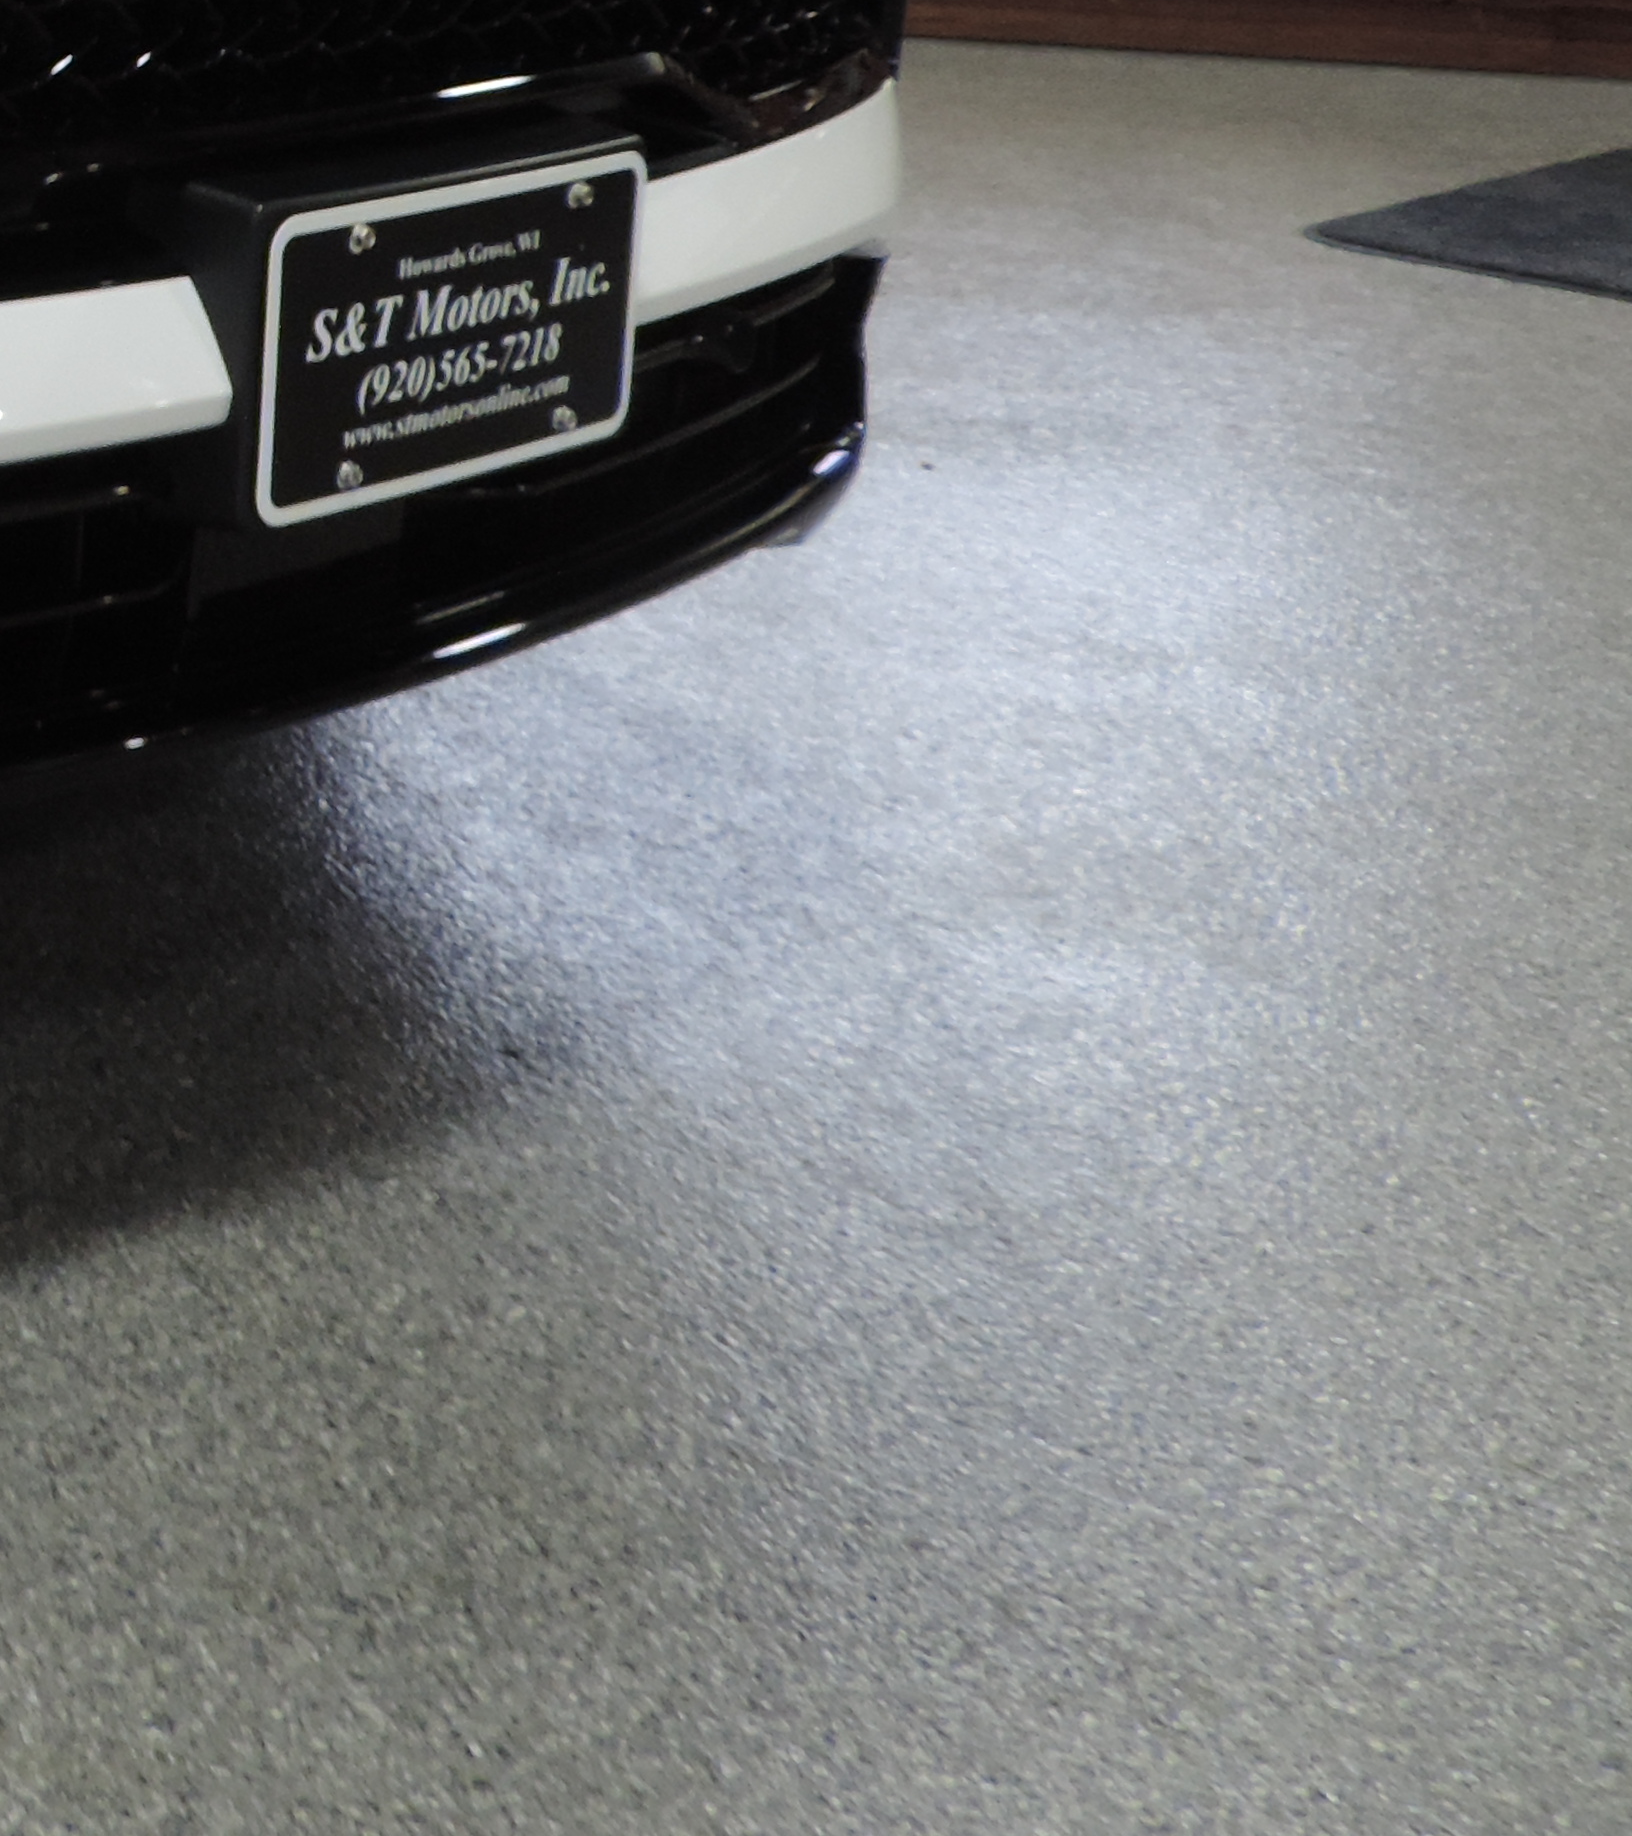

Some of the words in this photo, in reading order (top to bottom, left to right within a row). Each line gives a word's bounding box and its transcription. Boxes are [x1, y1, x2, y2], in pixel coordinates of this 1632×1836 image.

[399, 248, 466, 280] Howards
[518, 229, 541, 252] WI
[305, 294, 404, 363] S&T
[408, 281, 540, 341] Motors,
[549, 258, 611, 306] Inc.
[357, 324, 563, 415] (920)565-7218
